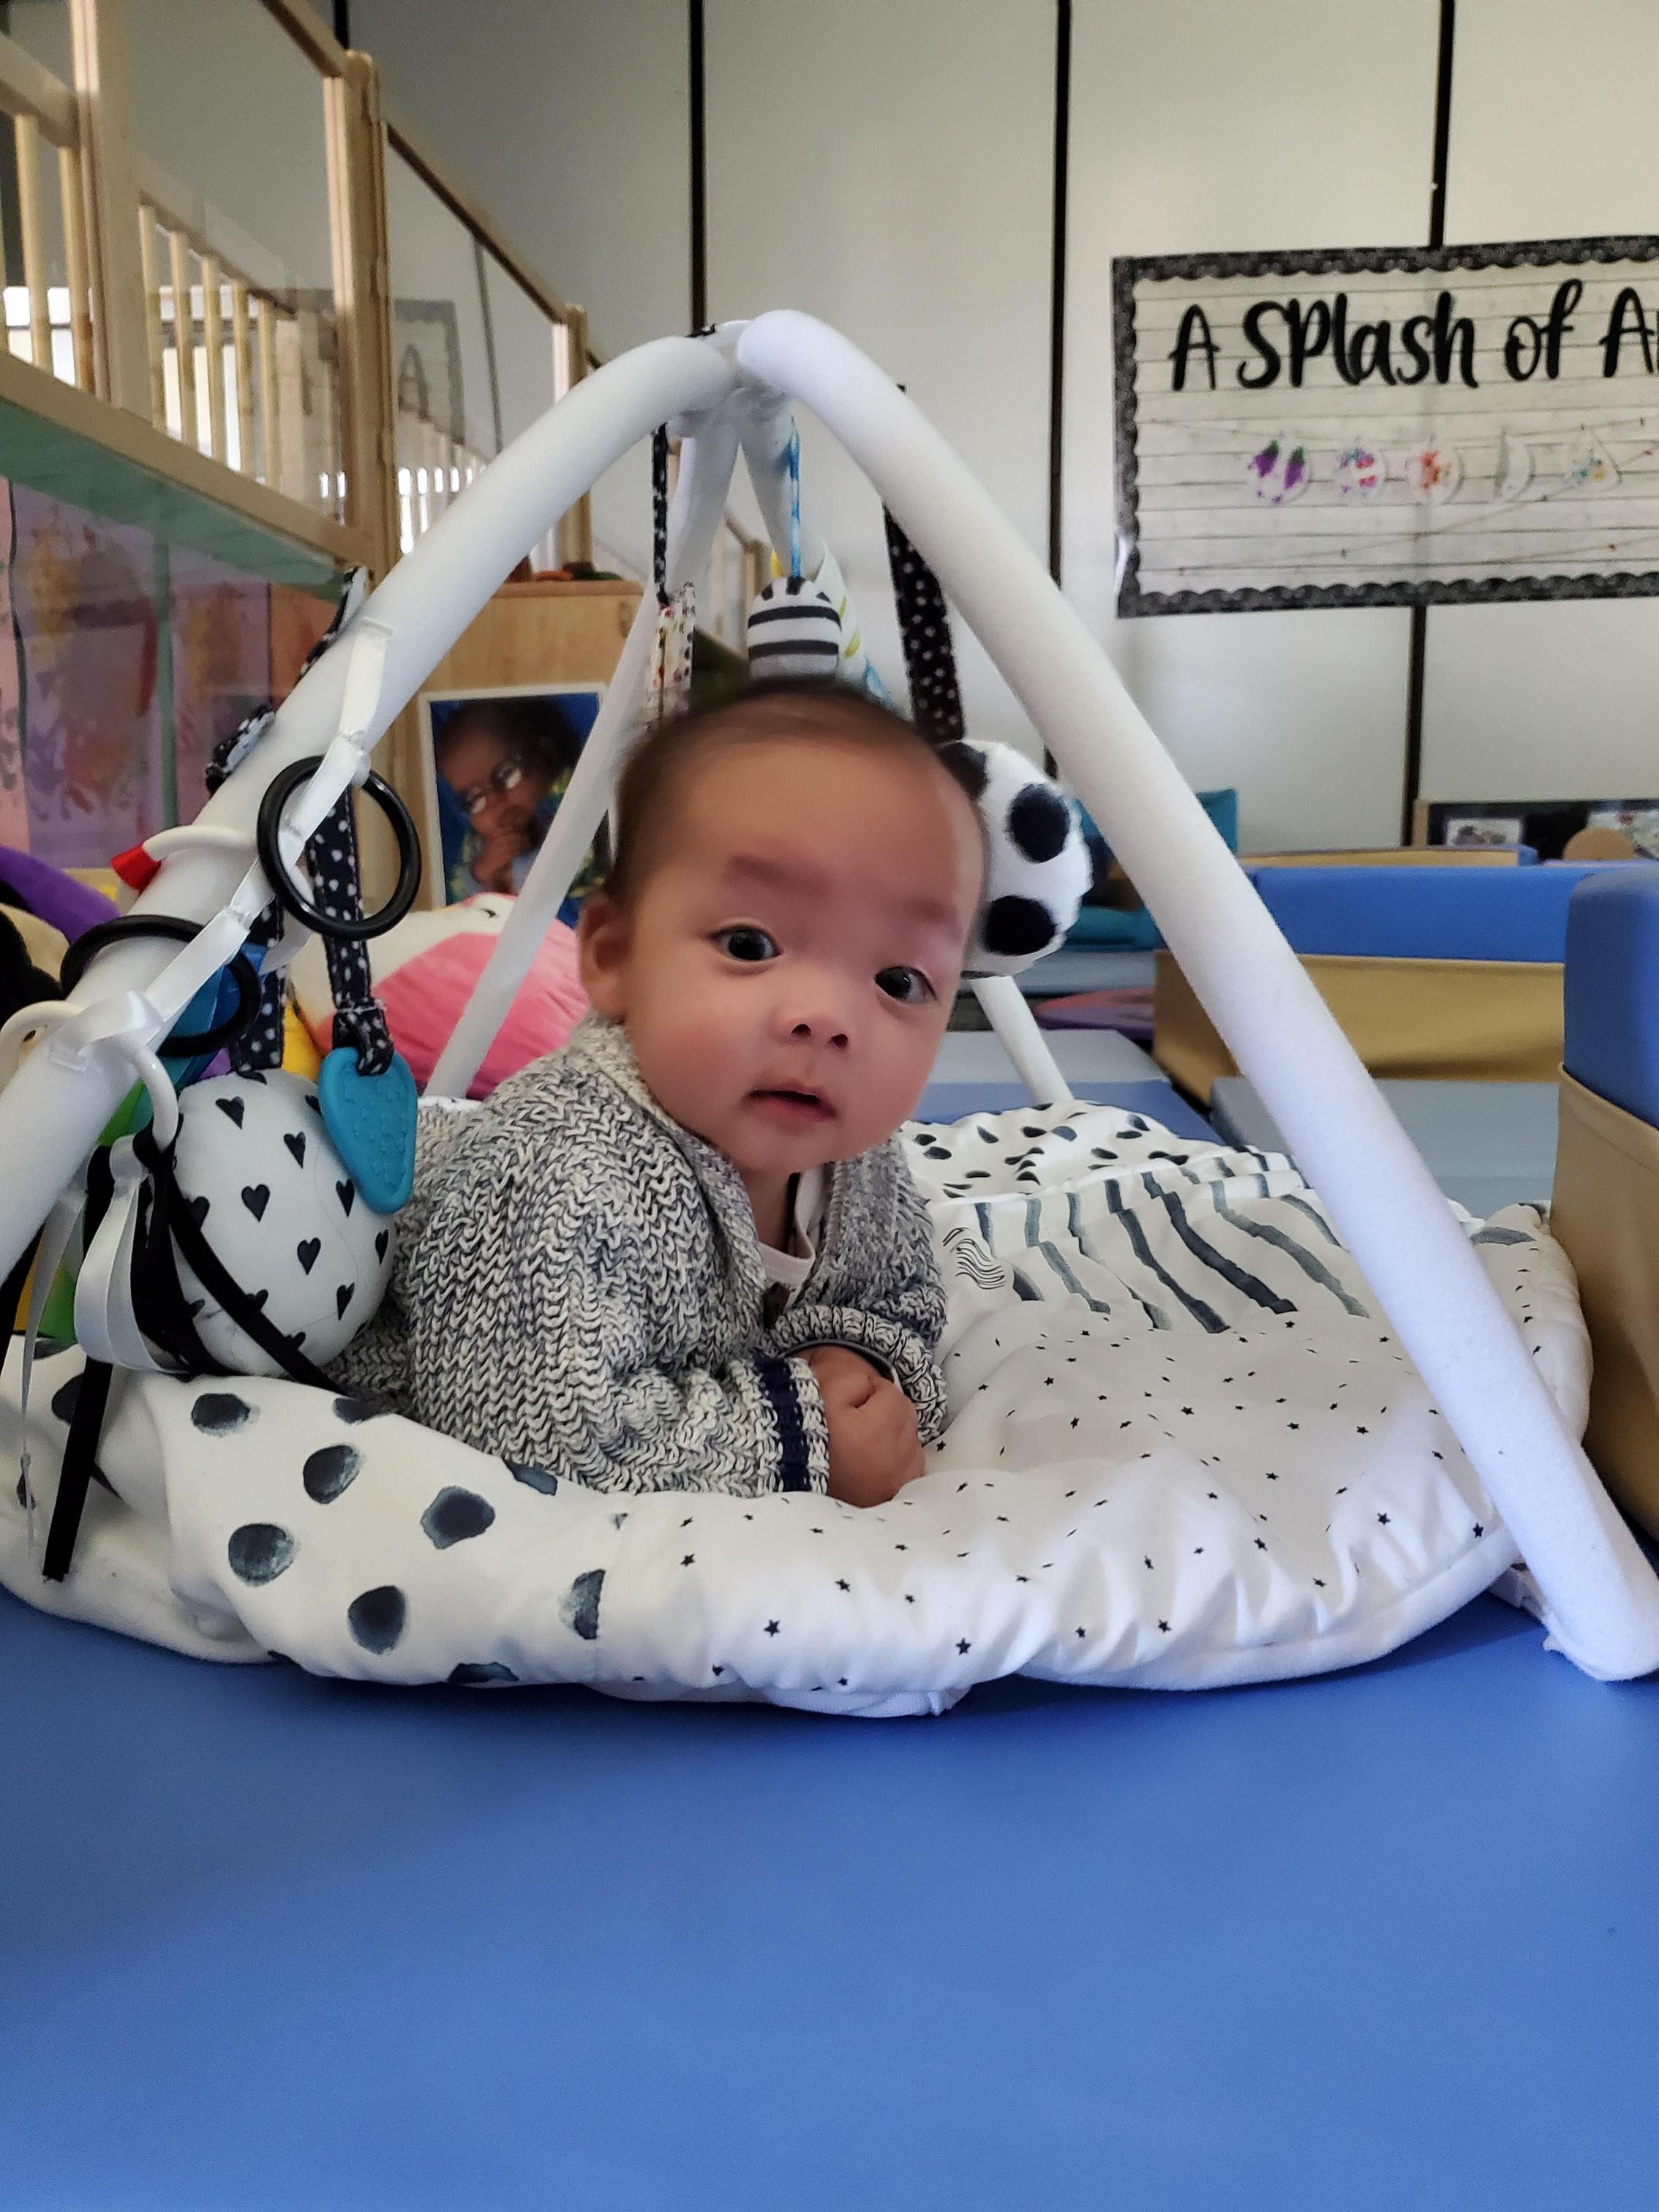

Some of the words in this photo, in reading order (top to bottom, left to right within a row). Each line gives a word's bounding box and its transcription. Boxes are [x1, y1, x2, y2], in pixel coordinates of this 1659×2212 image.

[1168, 304, 1221, 392] A
[1503, 277, 1584, 382] of
[1598, 286, 1659, 378] A
